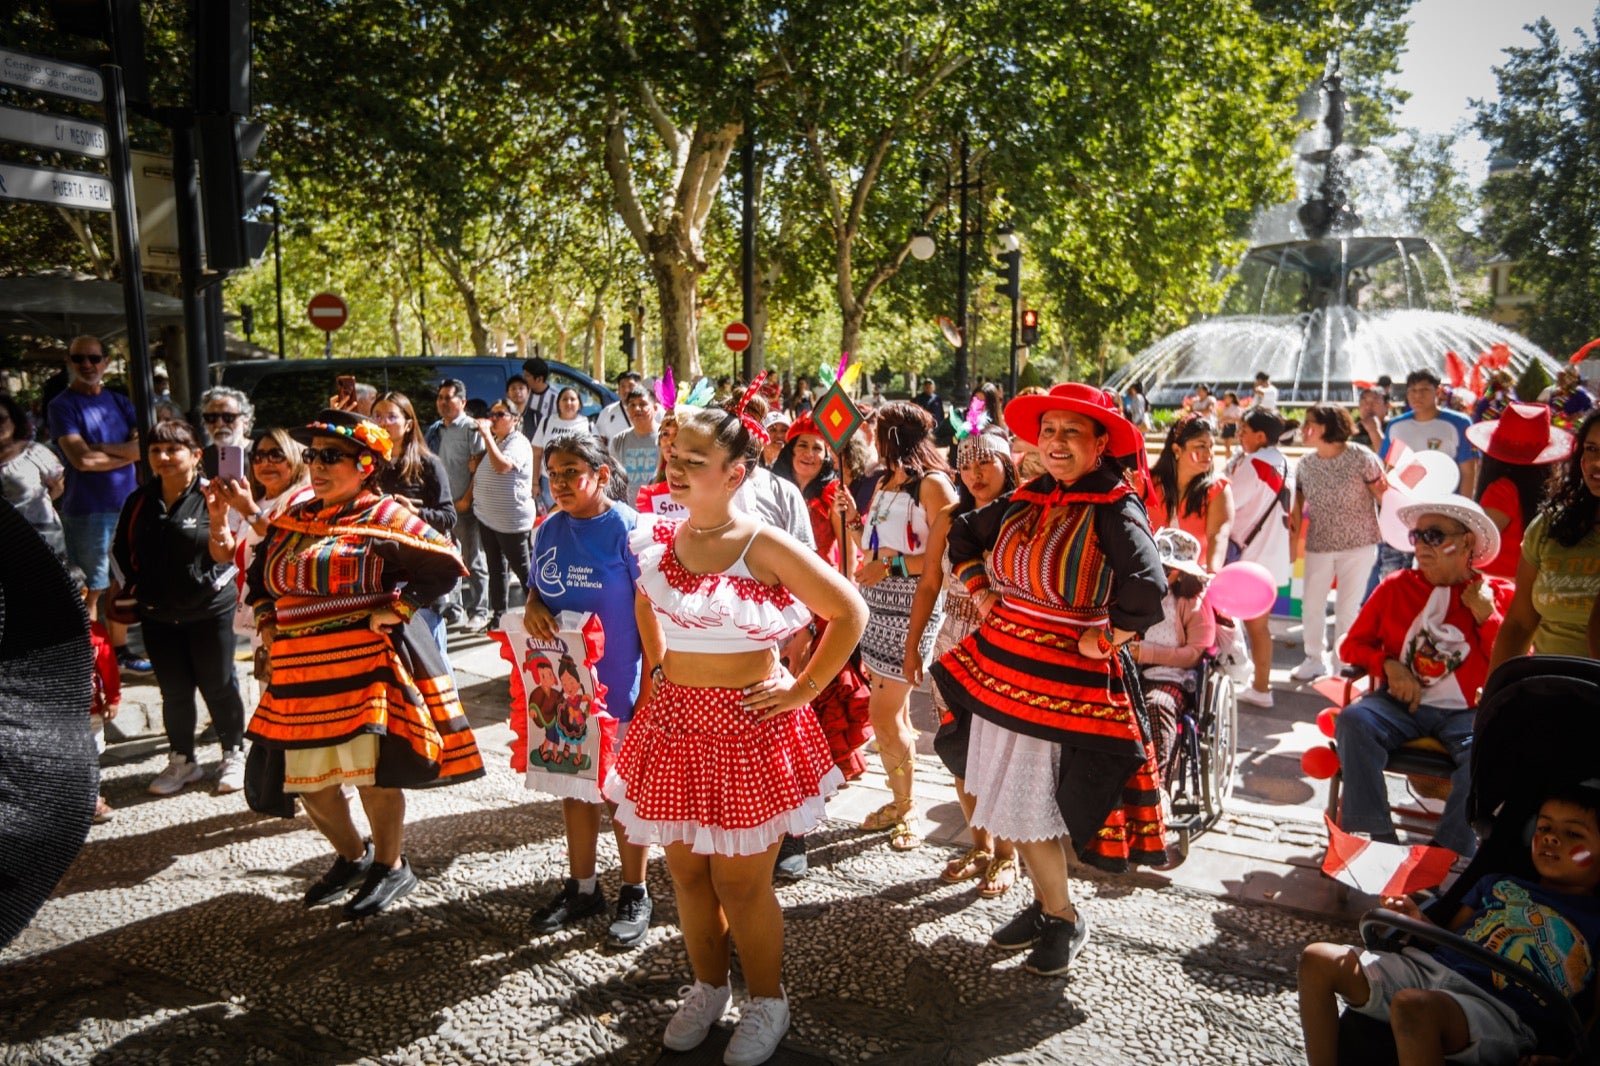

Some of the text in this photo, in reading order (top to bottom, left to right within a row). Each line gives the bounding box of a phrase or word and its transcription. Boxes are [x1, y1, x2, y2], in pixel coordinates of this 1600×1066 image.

[5, 58, 95, 85] Centro Comercial
[48, 79, 59, 87] de
[61, 82, 98, 97] Granada
[70, 128, 103, 149] MESONES
[53, 180, 109, 202] PUERTA REAL
[567, 573, 587, 582] Amigas
[568, 565, 593, 574] Ciudades
[580, 581, 603, 589] Infancia
[529, 638, 564, 652] SIERRA
